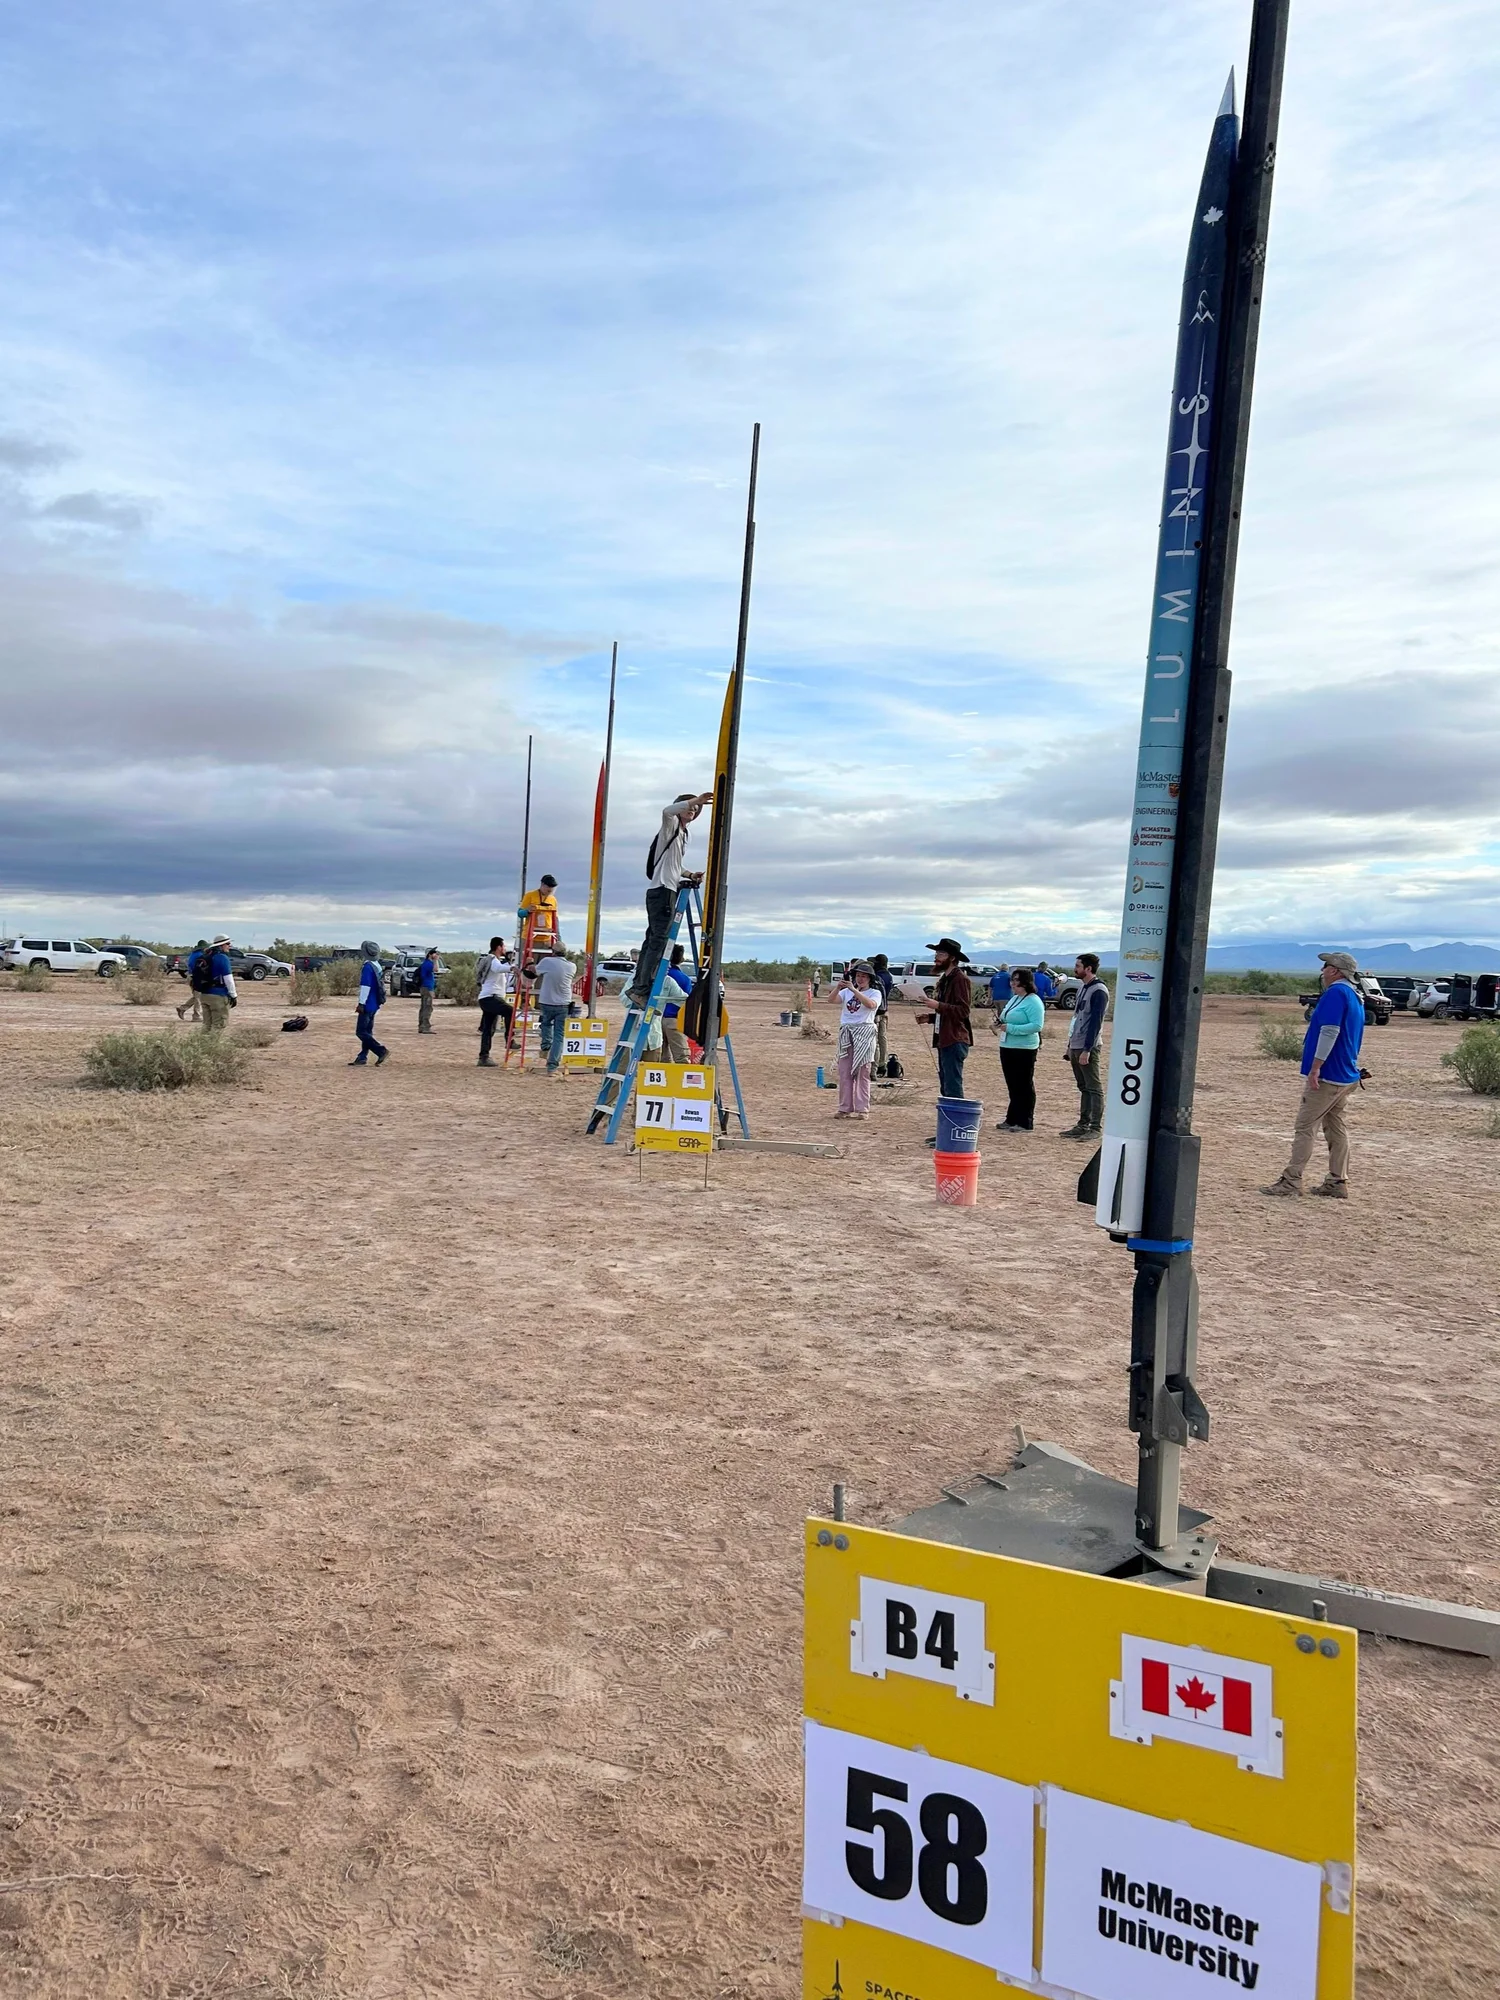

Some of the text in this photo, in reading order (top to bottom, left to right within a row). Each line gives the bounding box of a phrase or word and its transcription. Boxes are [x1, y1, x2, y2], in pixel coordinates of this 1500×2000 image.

[1138, 772, 1180, 782] McMaster
[1127, 926, 1163, 936] KENESTO
[567, 1041, 580, 1052] 52
[650, 1072, 661, 1082] B3
[1120, 1038, 1144, 1106] 58
[646, 1100, 664, 1122] 77
[885, 1598, 958, 1670] B4
[845, 1766, 988, 1926] 58
[1100, 1867, 1259, 1946] McMaster
[1098, 1905, 1259, 1990] University
